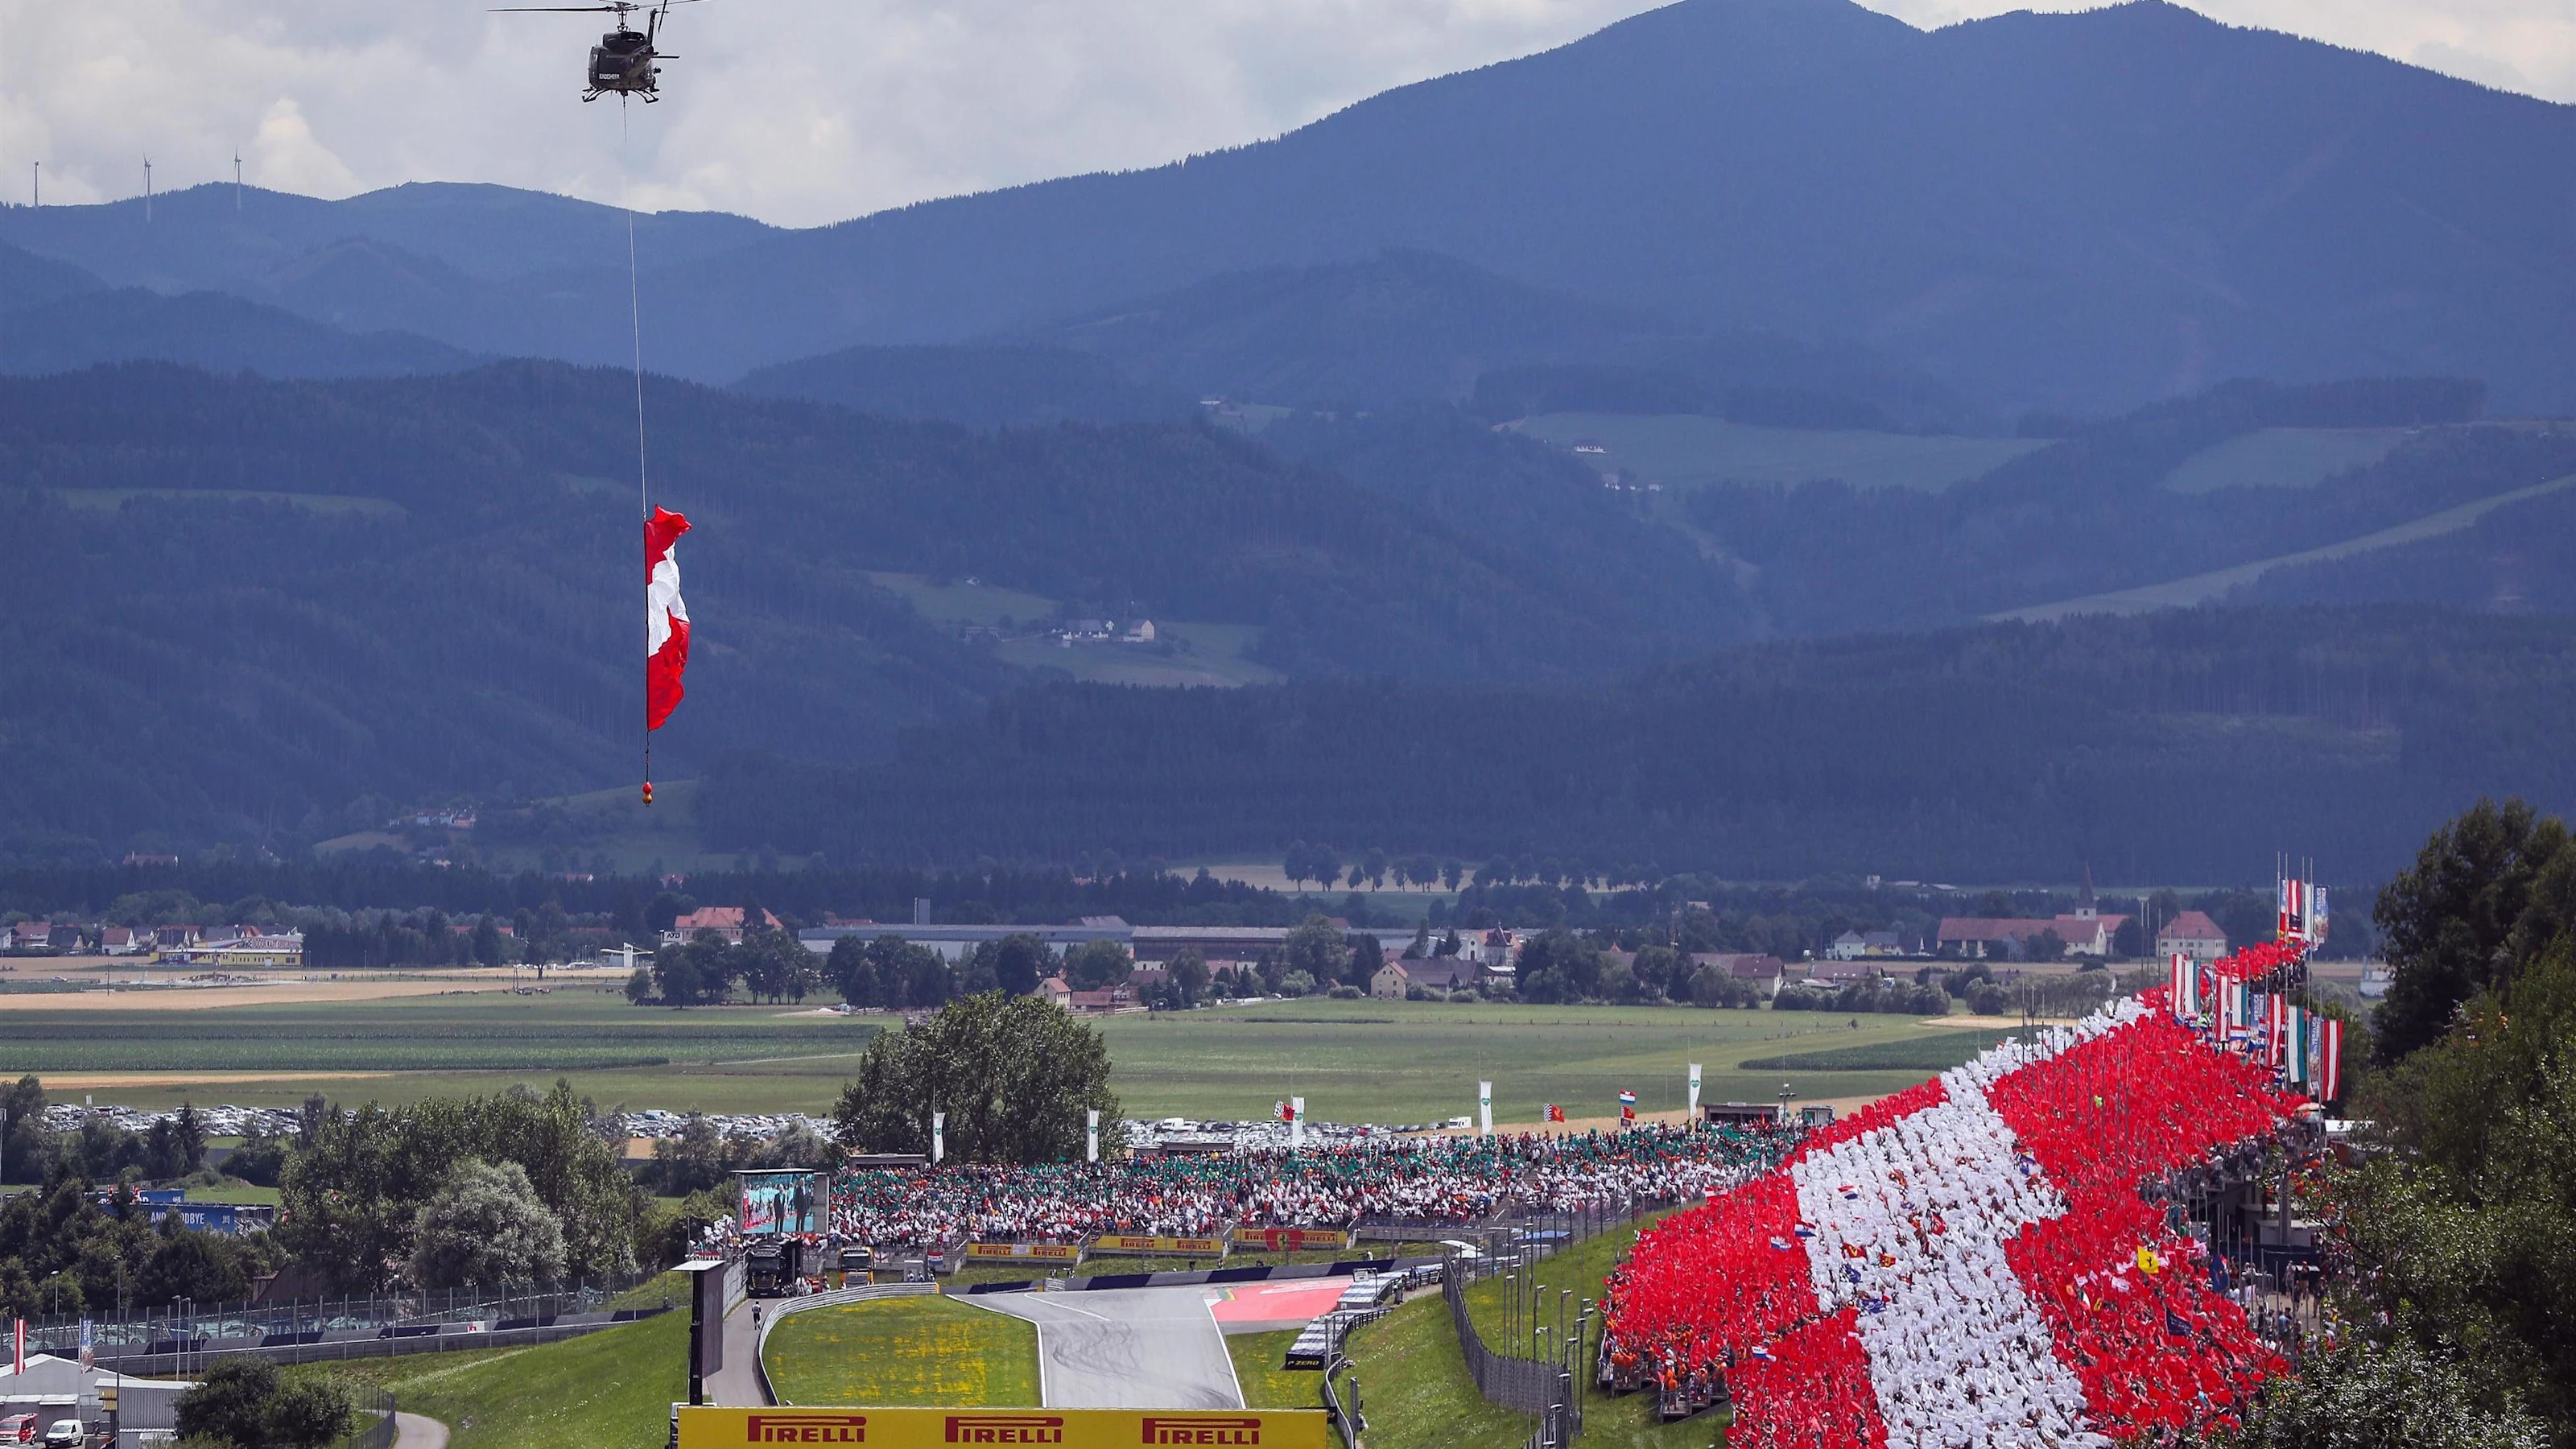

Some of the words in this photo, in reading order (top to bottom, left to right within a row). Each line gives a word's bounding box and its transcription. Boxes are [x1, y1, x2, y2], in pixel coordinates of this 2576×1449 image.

[1121, 1237, 1155, 1248] PIRELLI
[1177, 1240, 1212, 1250] PIRELLI
[977, 1245, 1012, 1256] PIRELLI
[1033, 1246, 1067, 1257] PIRELLI
[747, 1415, 867, 1443] PIRELLI
[945, 1416, 1064, 1443] PIRELLI
[1141, 1418, 1261, 1445] PIRELLI
